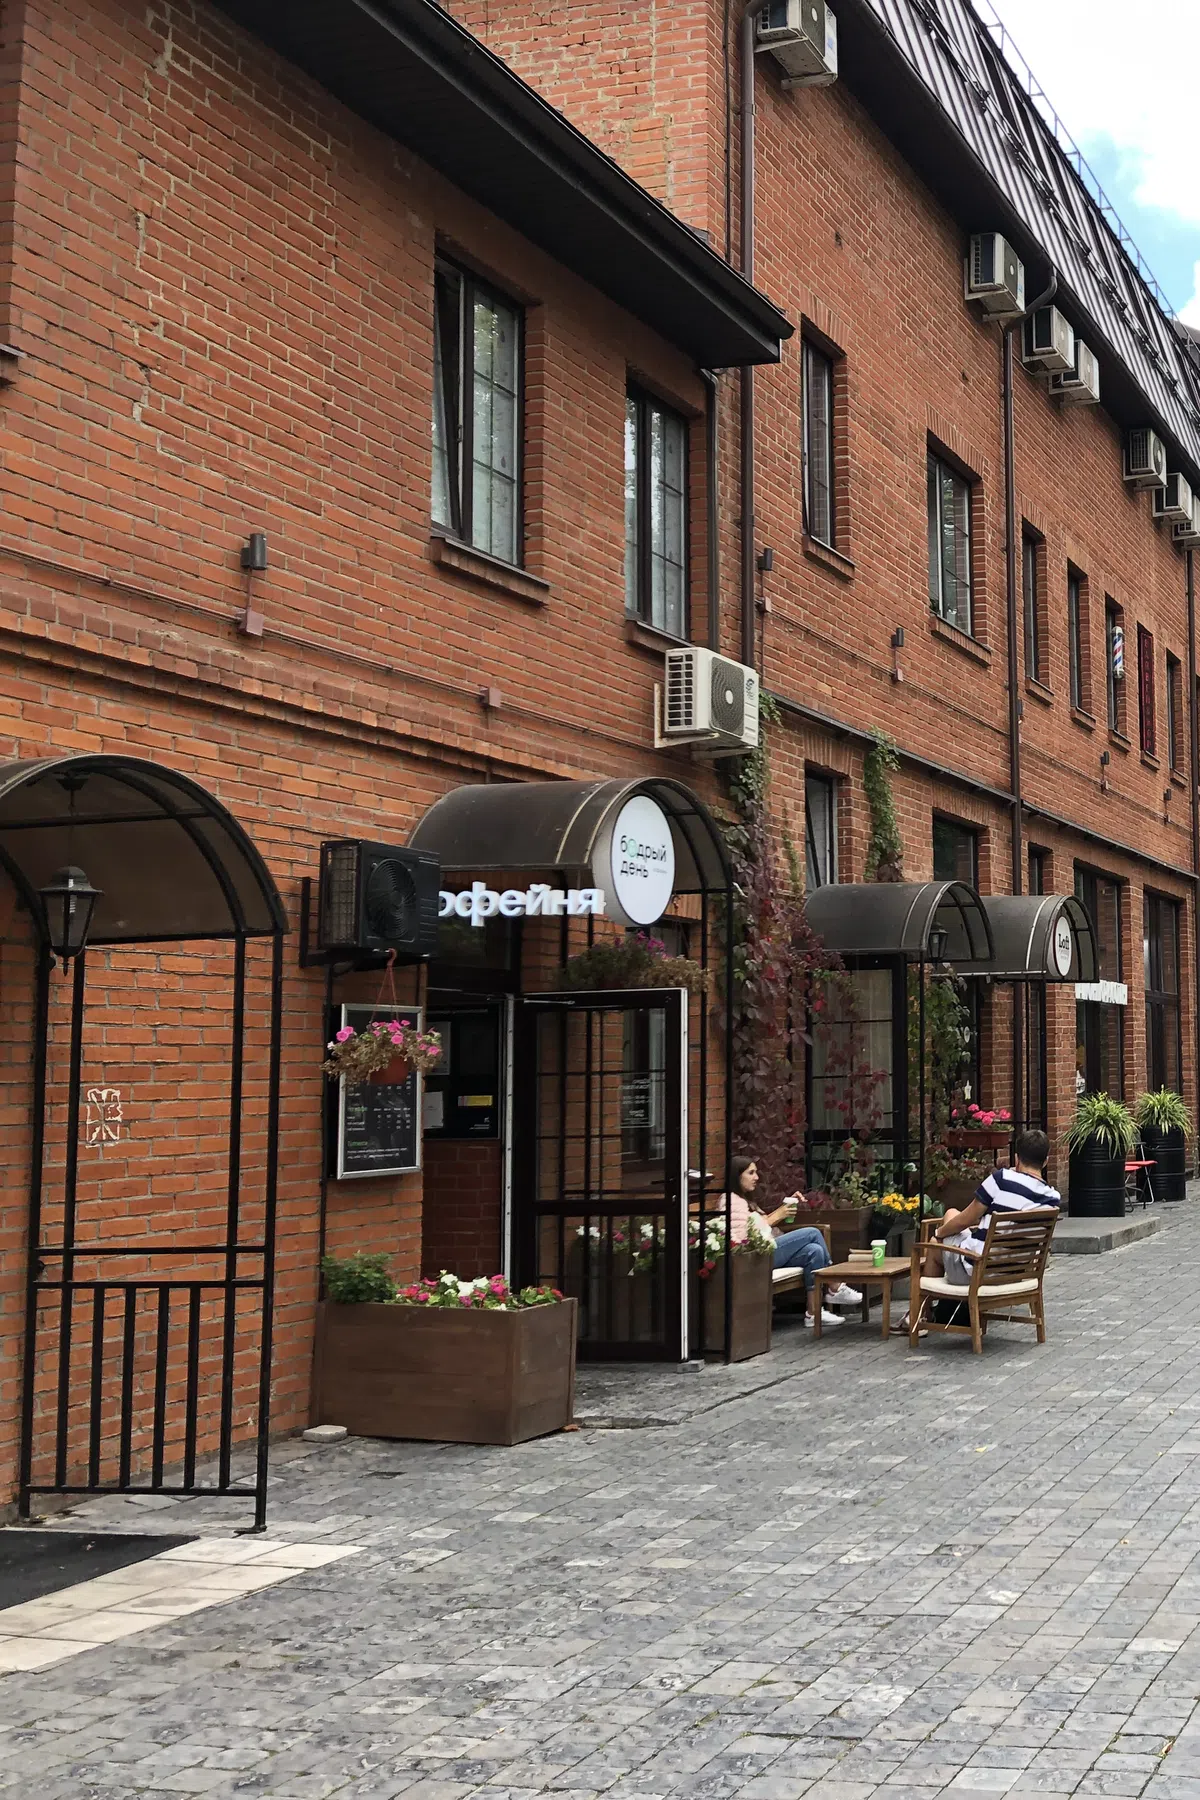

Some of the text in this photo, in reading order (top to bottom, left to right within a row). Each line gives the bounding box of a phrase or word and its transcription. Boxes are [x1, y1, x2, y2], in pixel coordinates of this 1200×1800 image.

[621, 835, 667, 863] бодрый
[620, 860, 649, 878] день
[438, 881, 606, 927] офейня
[1058, 933, 1070, 949] Loft
